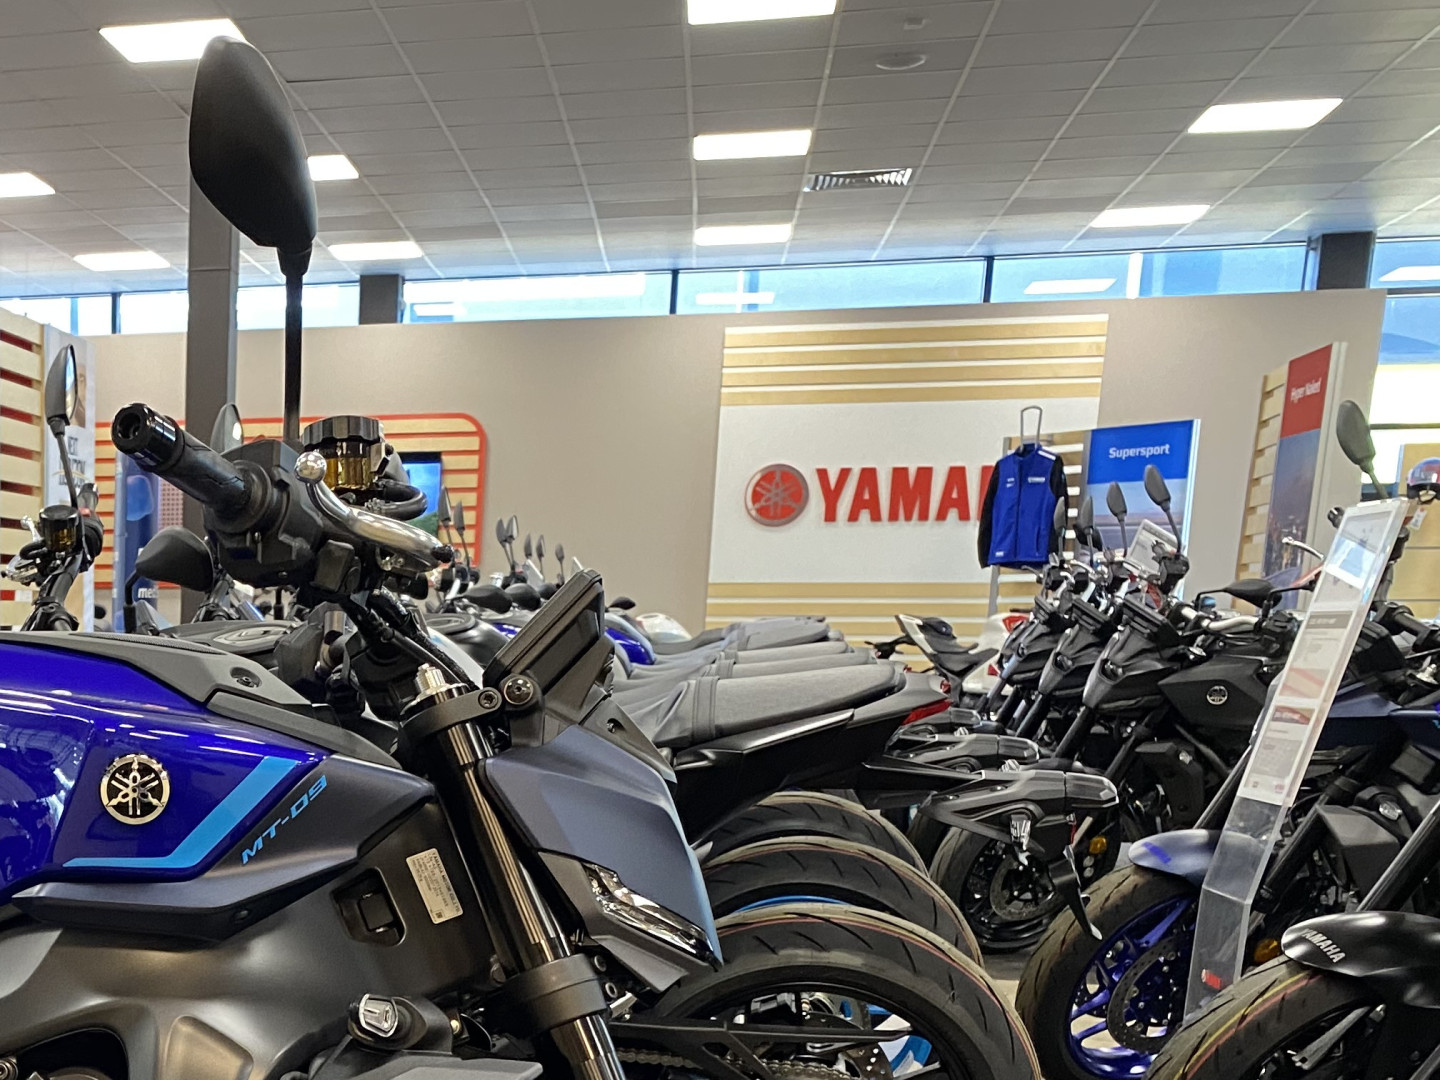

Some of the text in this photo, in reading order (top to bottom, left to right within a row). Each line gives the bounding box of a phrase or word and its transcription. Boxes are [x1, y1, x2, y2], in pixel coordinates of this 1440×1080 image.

[1108, 443, 1171, 461] Supersport
[815, 465, 996, 523] YAMA
[242, 774, 328, 865] MT-09
[1300, 928, 1347, 964] YAMAHA
